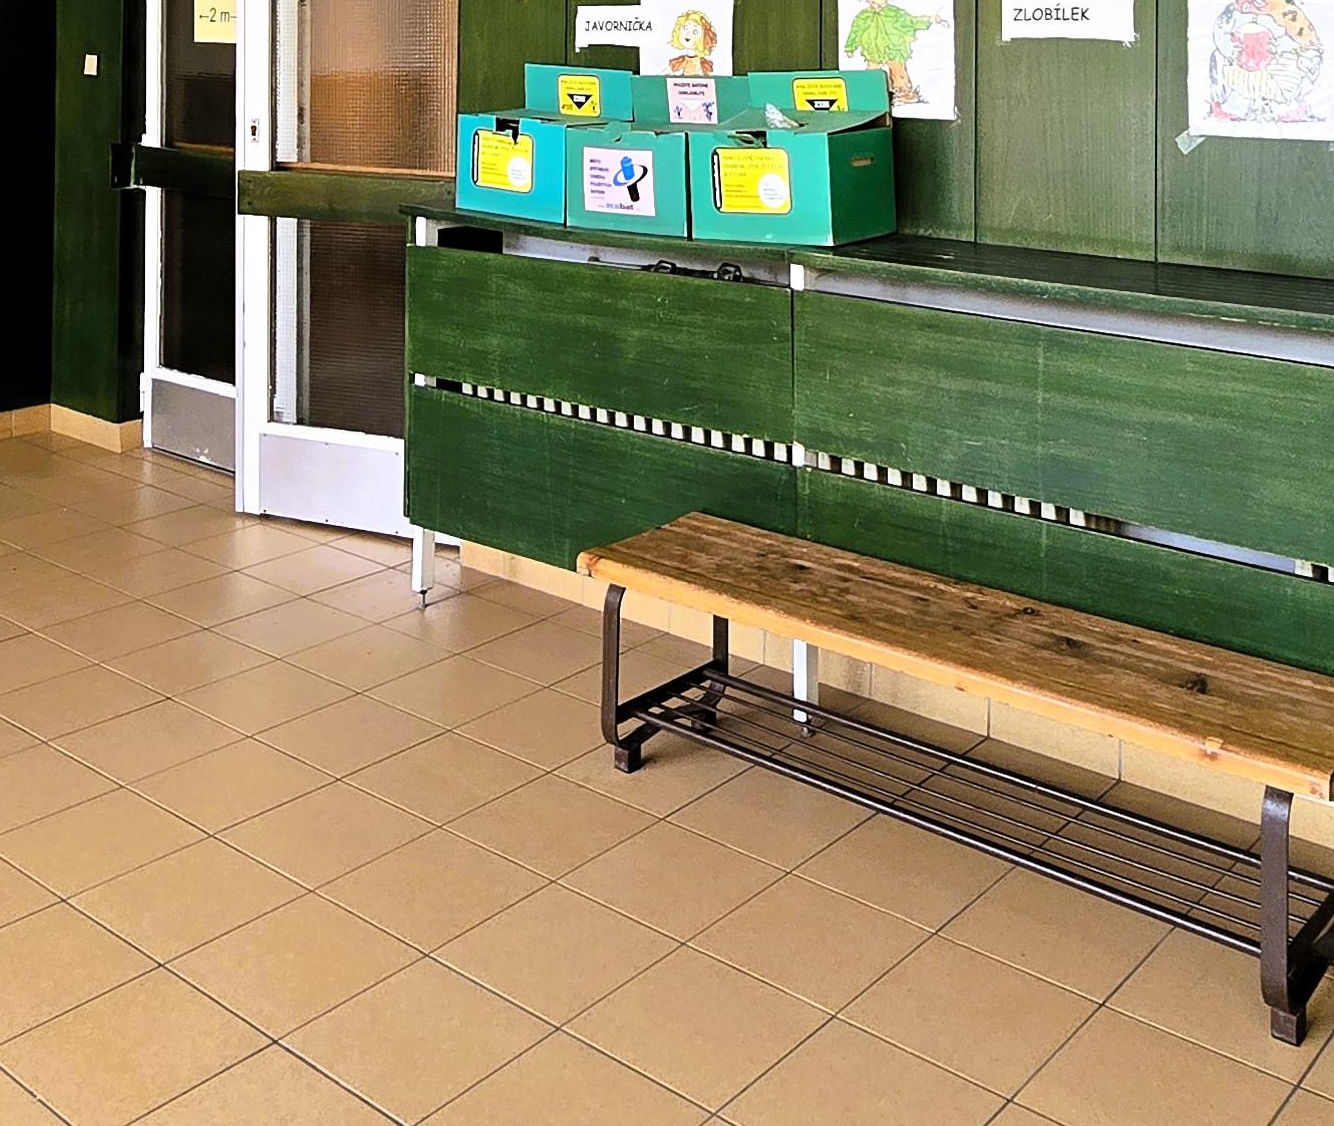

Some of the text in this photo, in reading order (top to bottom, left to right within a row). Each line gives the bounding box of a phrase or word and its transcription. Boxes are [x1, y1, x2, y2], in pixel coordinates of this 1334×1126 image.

[209, 7, 230, 23] 2 m
[1013, 5, 1090, 23] ZLOBÍLEK
[584, 17, 653, 32] JAVORNIČKA
